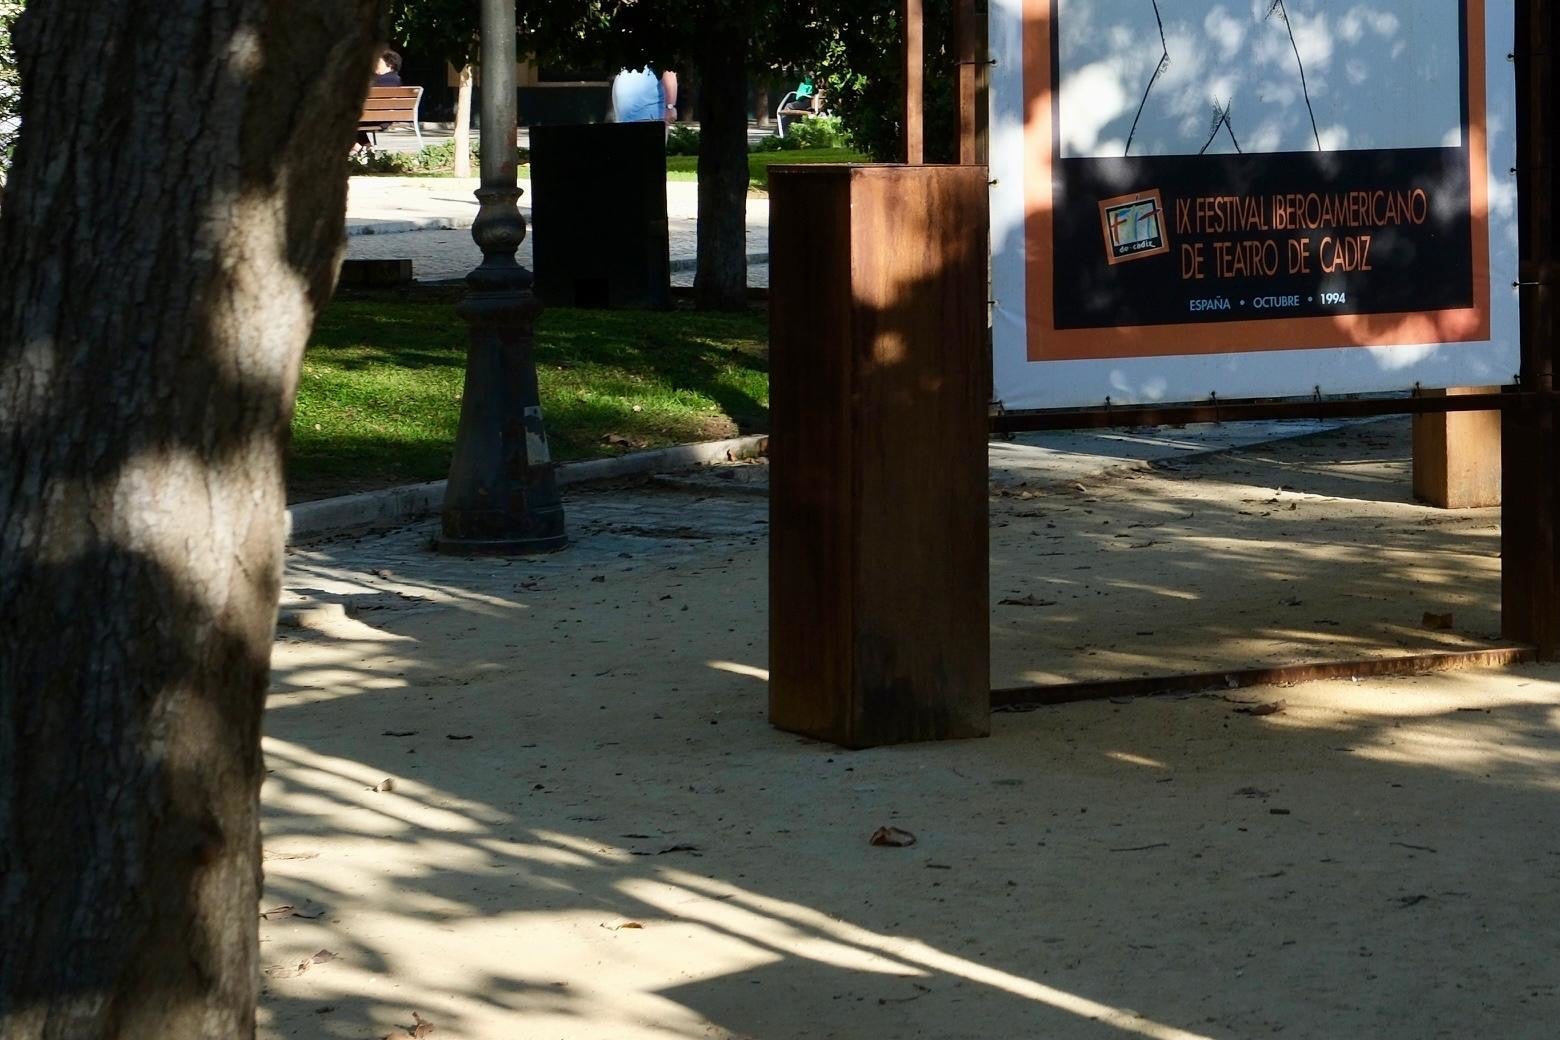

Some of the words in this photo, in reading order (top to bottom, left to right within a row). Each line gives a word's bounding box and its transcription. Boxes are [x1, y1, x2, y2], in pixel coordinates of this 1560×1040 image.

[1176, 198, 1192, 234] IX
[1196, 195, 1269, 233] FESTIVAL
[1272, 188, 1427, 230] IBEROAMERICANO
[1182, 243, 1205, 279] DE
[1213, 239, 1279, 278] TEATRO
[1288, 238, 1311, 274] DE
[1320, 235, 1373, 273] CADIZ
[1189, 295, 1231, 312] ESPAÑA
[1252, 295, 1300, 309] OCTUBRE
[1320, 292, 1346, 305] 1994
